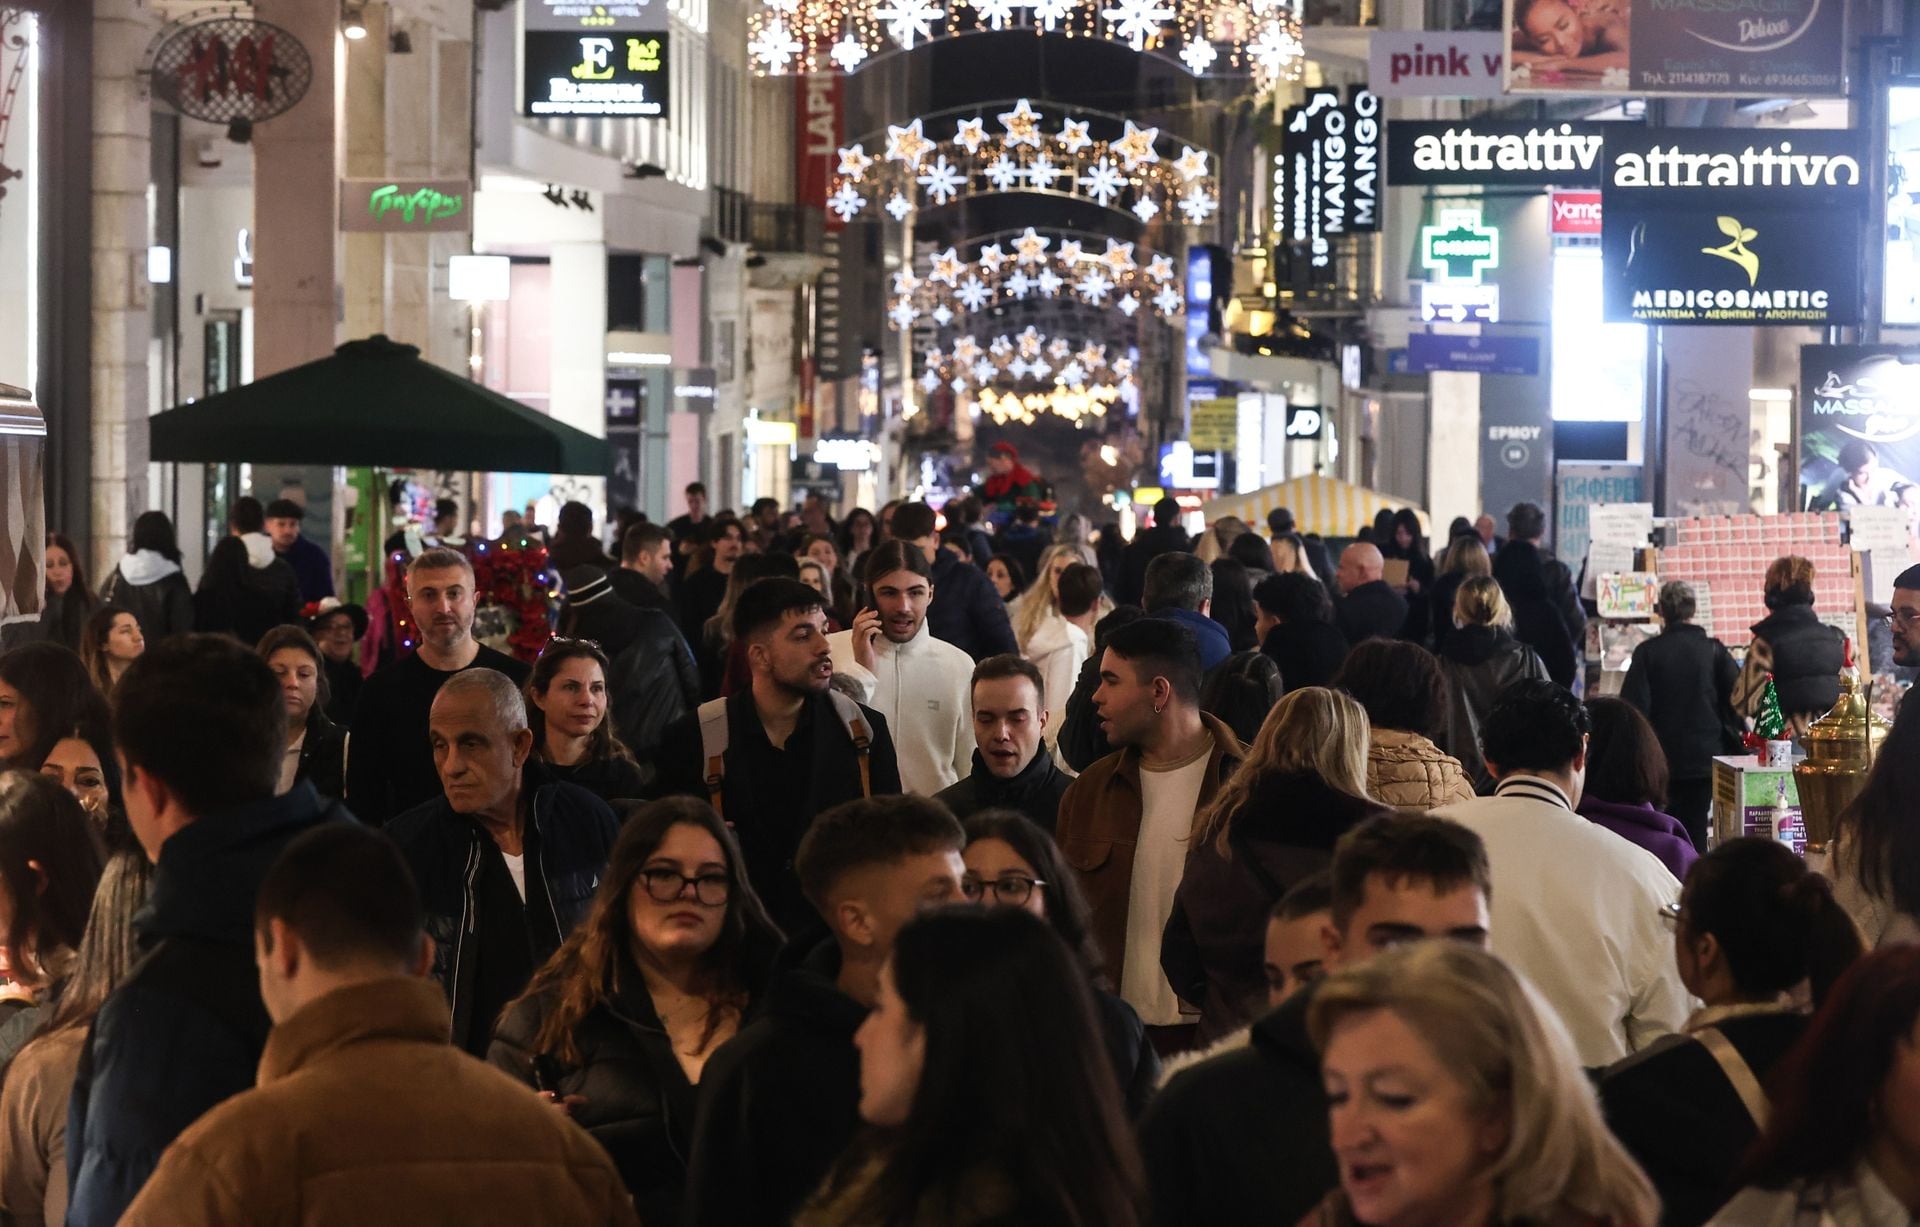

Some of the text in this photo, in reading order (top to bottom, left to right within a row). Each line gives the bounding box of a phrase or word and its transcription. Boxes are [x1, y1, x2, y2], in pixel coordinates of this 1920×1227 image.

[1390, 43, 1470, 84] pink
[1354, 90, 1378, 225] MANGO
[1414, 123, 1603, 171] attrattiv
[1614, 141, 1860, 186] attrattivo
[1324, 110, 1346, 232] MANGO
[1632, 290, 1829, 308] MEDICOSMETIC
[1632, 310, 1827, 319] ΑΔΥΝΑΤΙΣΜΑ ΑΙΣΘΗΤΙΚΗ ΑΠΟΤΡΙΧΩΣΗ
[1488, 426, 1541, 440] ΕΡΜΟΥ
